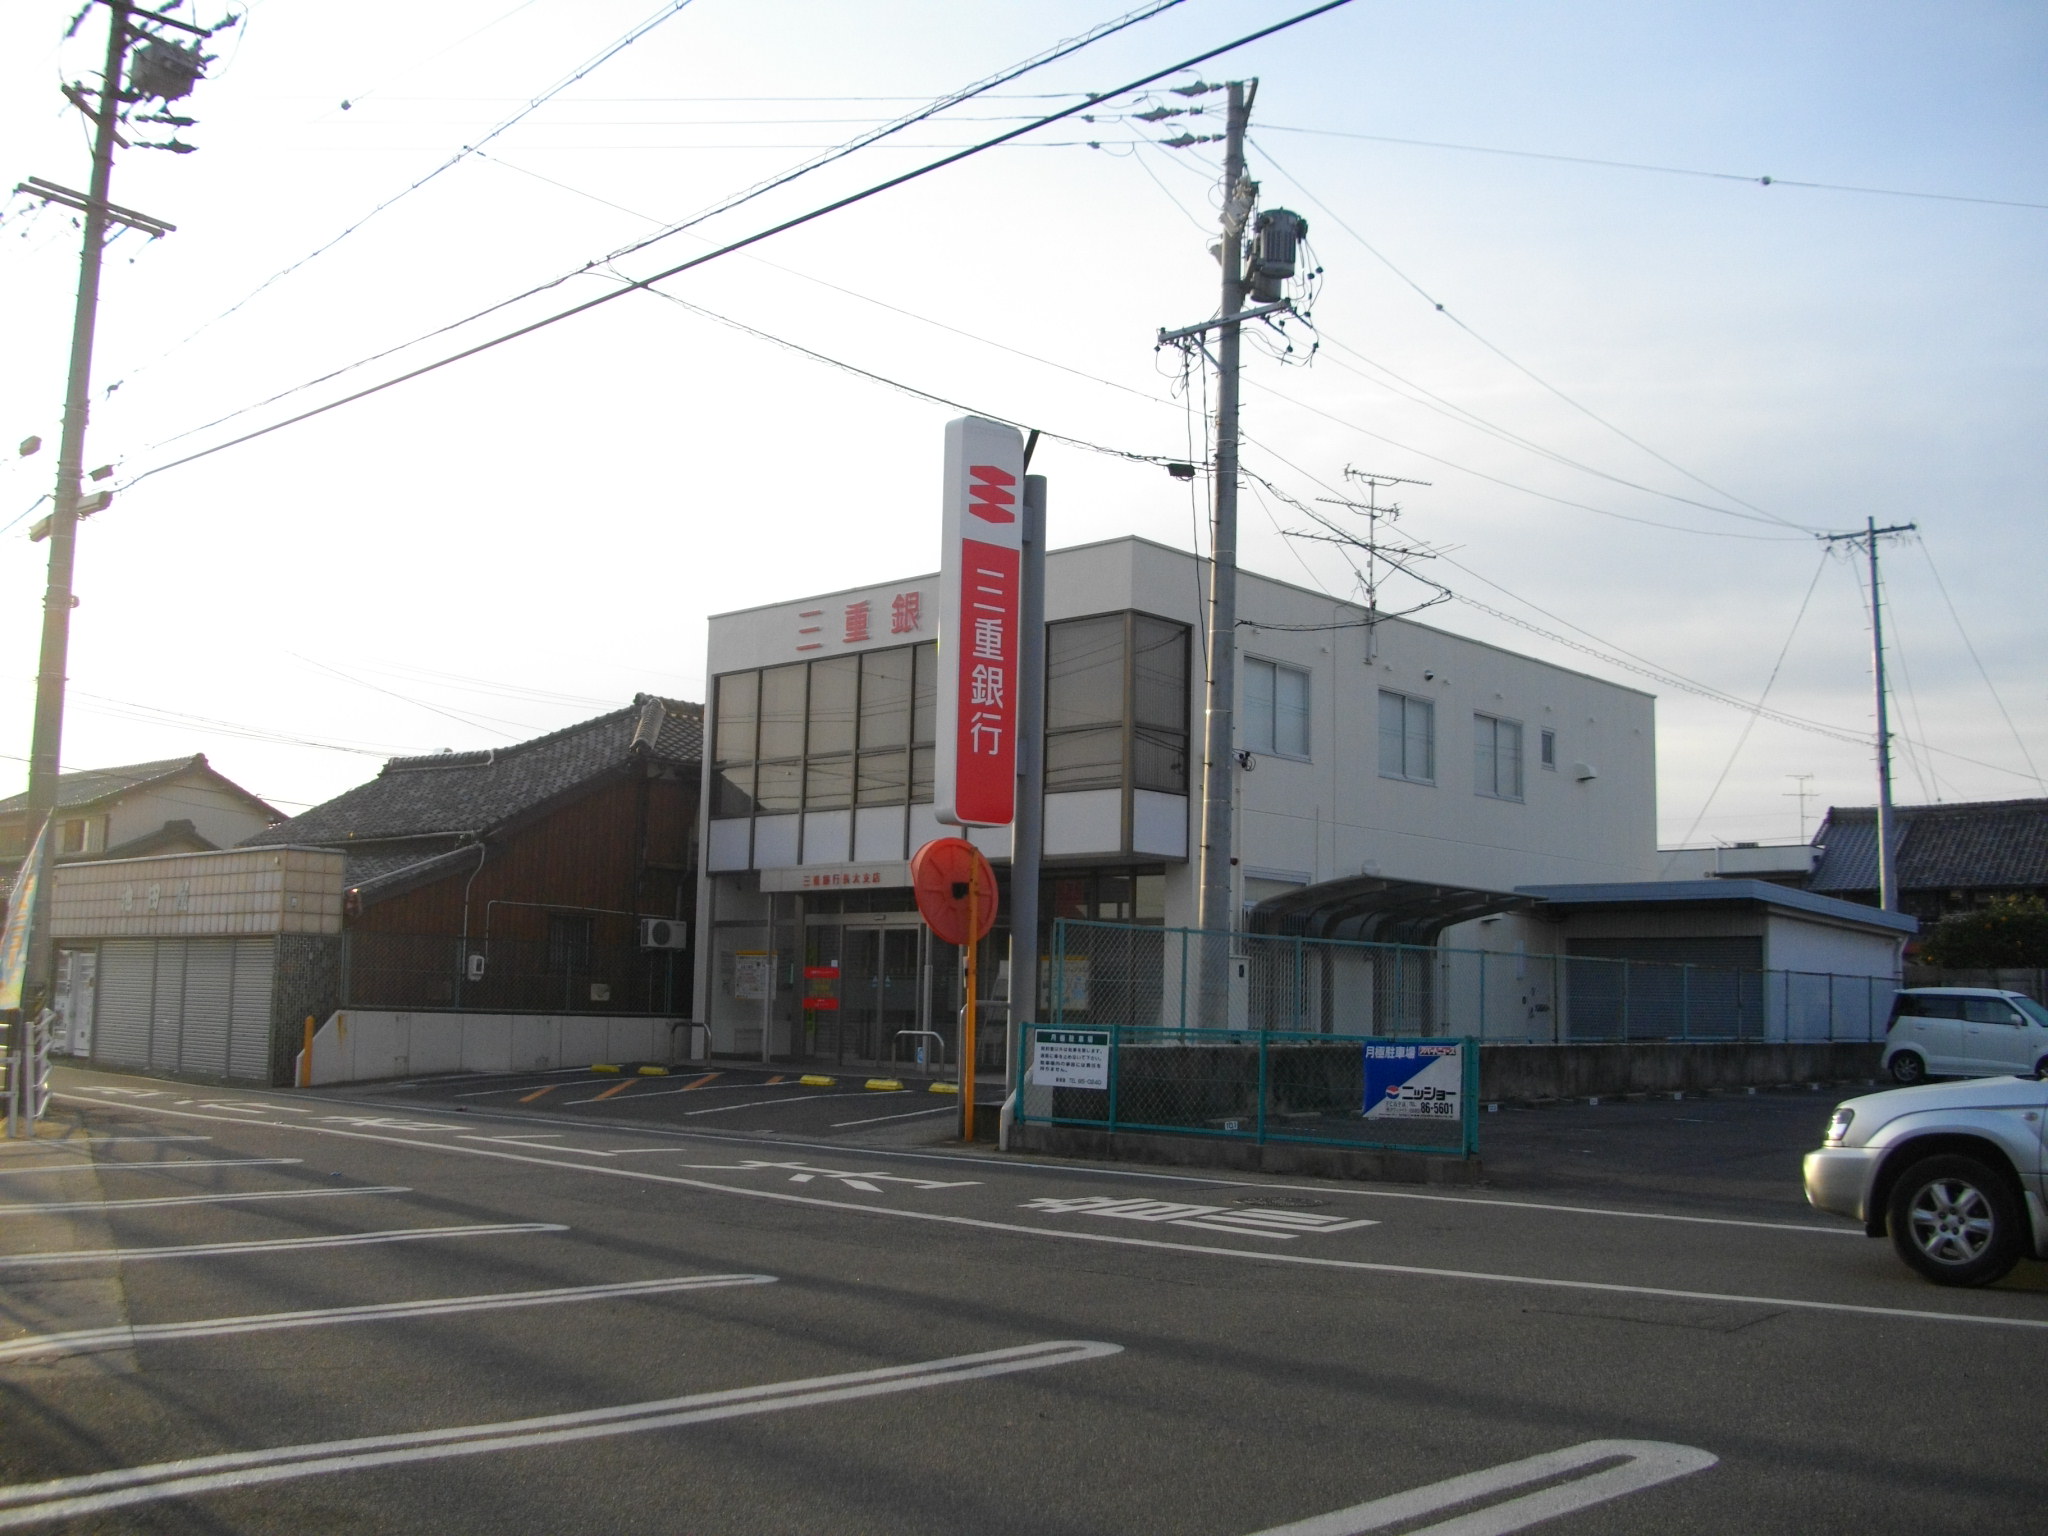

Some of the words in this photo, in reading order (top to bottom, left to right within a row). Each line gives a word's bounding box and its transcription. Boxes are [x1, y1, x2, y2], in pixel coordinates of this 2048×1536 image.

[971, 568, 1006, 756] 三重銀行
[1365, 1046, 1415, 1059] 月極駐車場
[1402, 1086, 1456, 1100] ニッショー
[1420, 1102, 1454, 1114] 86-5601
